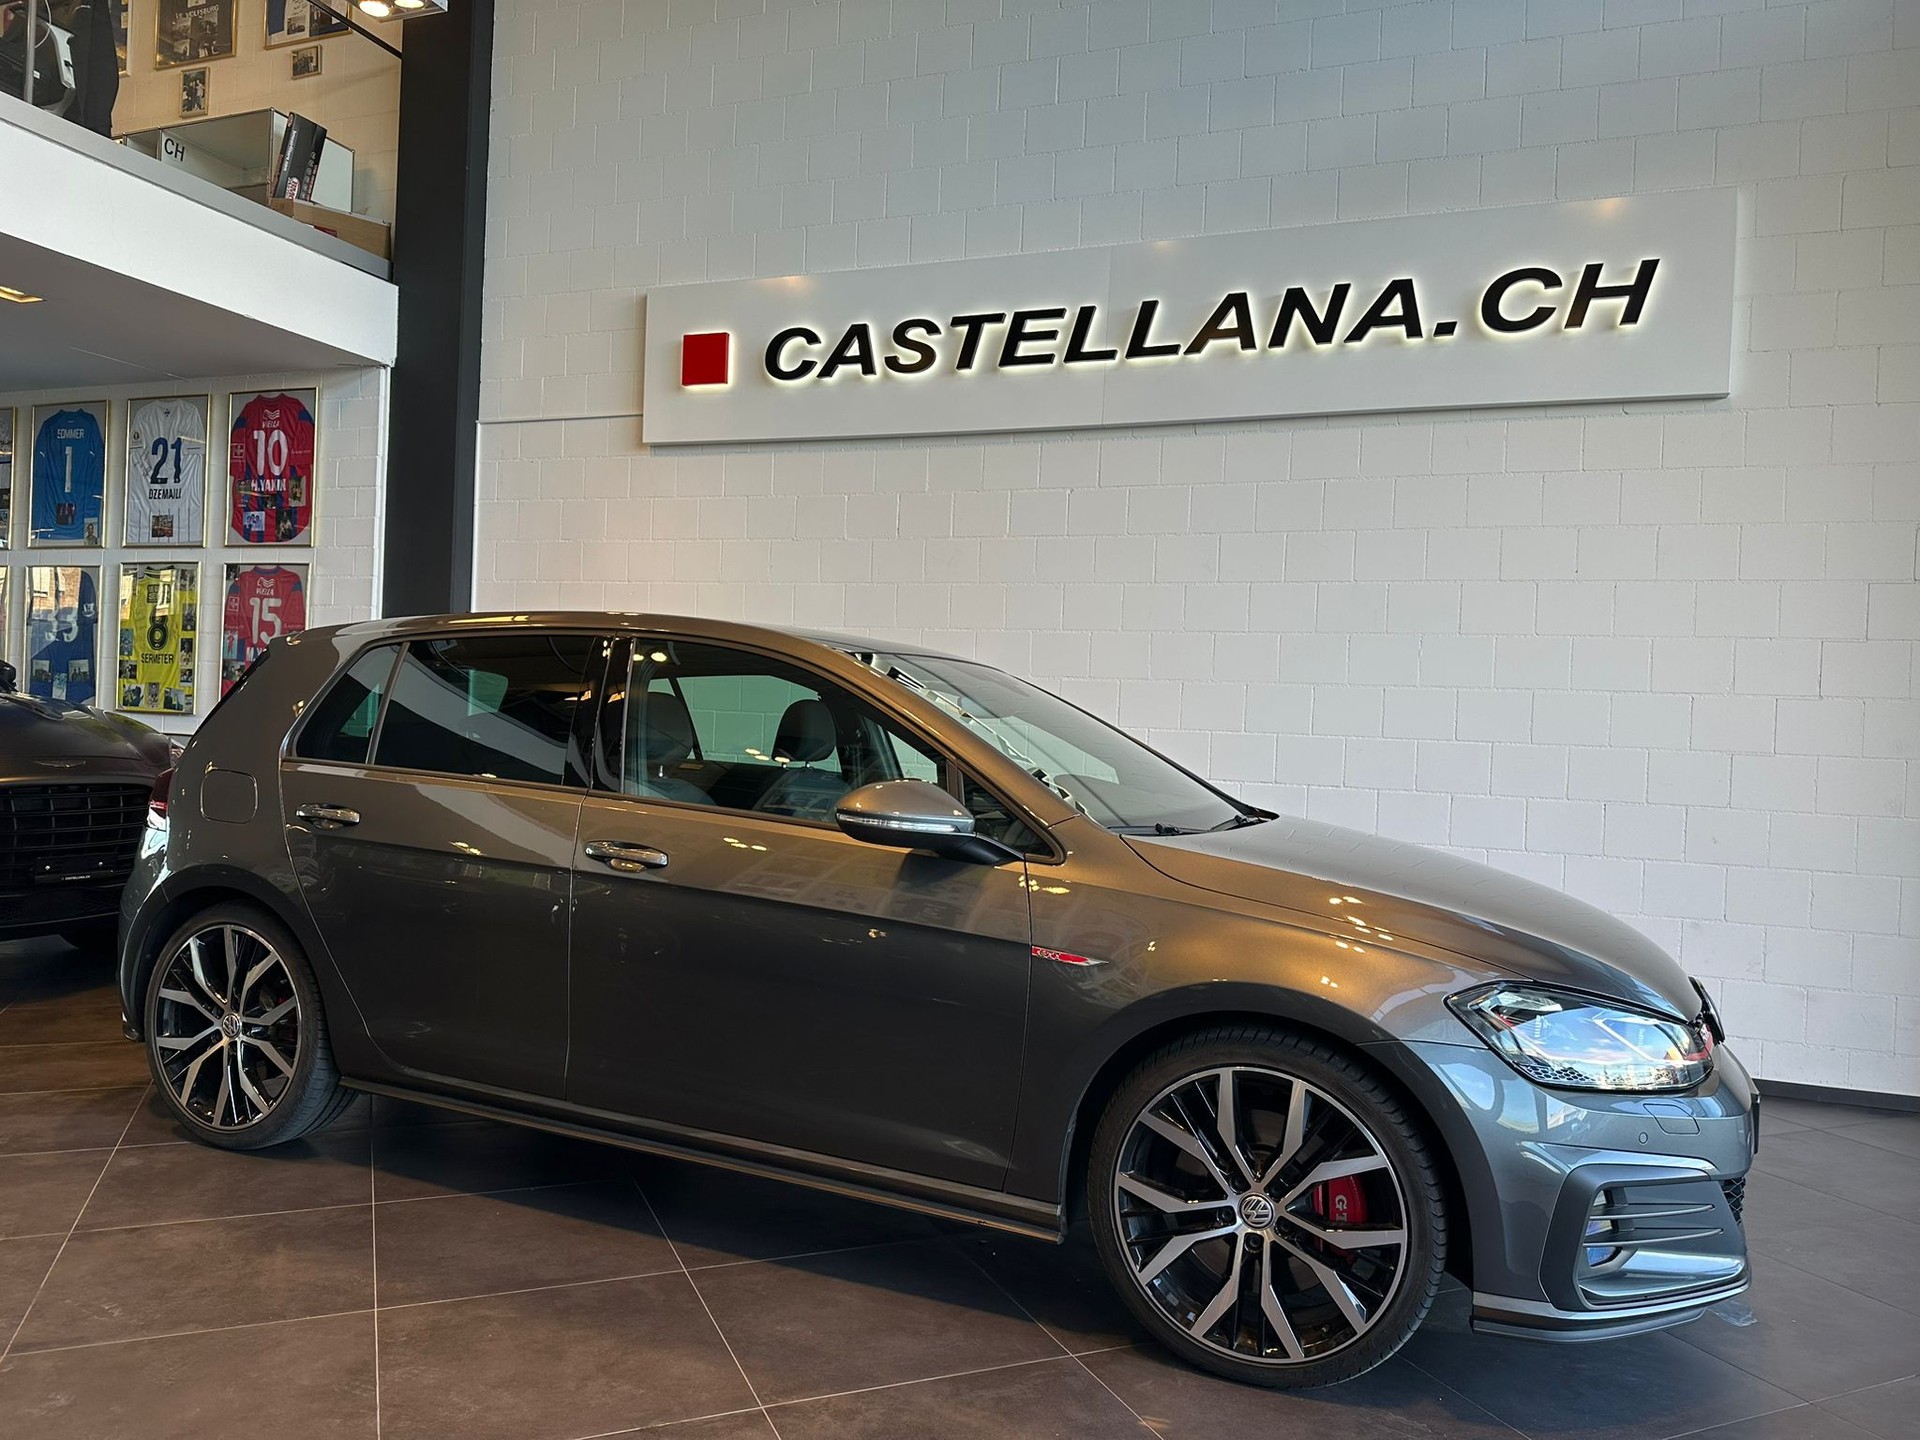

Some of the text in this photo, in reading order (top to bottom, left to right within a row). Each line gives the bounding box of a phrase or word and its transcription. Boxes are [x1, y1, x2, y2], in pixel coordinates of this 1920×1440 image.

[164, 137, 185, 162] CH
[764, 258, 1660, 381] CASTELLANA.CH
[57, 428, 85, 439] SOMMER
[253, 429, 288, 477] 10
[64, 445, 73, 494] 1
[150, 436, 182, 485] 21
[146, 604, 169, 651] 8
[249, 597, 282, 645] 15
